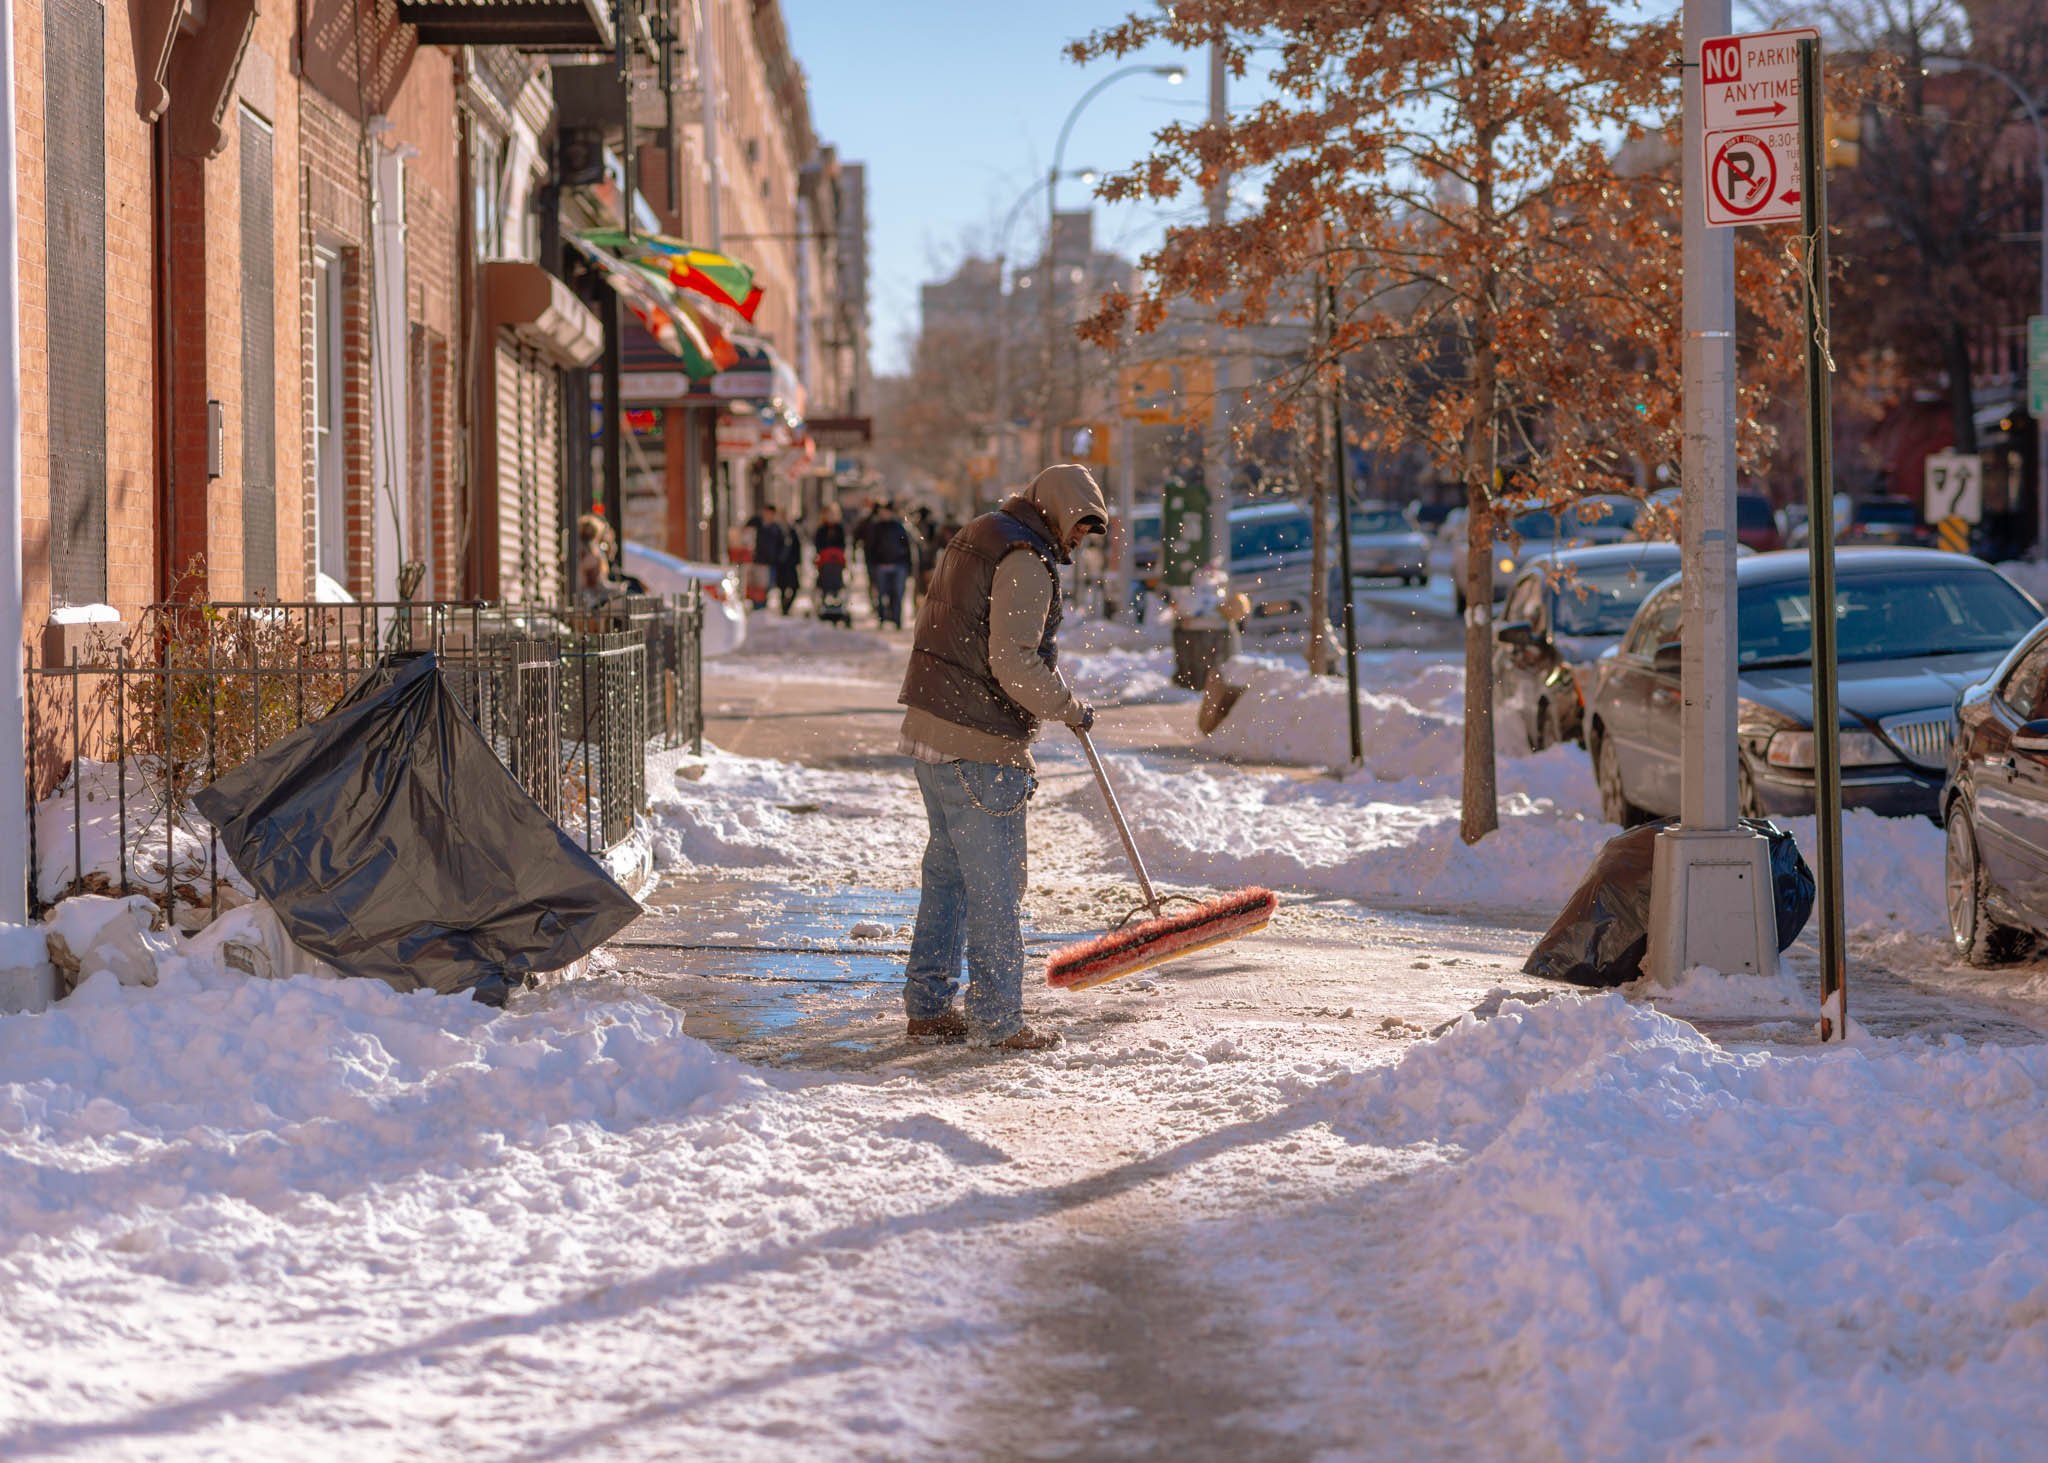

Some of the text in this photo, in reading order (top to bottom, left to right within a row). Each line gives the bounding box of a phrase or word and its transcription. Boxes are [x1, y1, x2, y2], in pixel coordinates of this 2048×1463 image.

[1706, 46, 1798, 80] NO PARKIN
[1724, 78, 1800, 103] ANYTIME
[1791, 174, 1801, 184] FR
